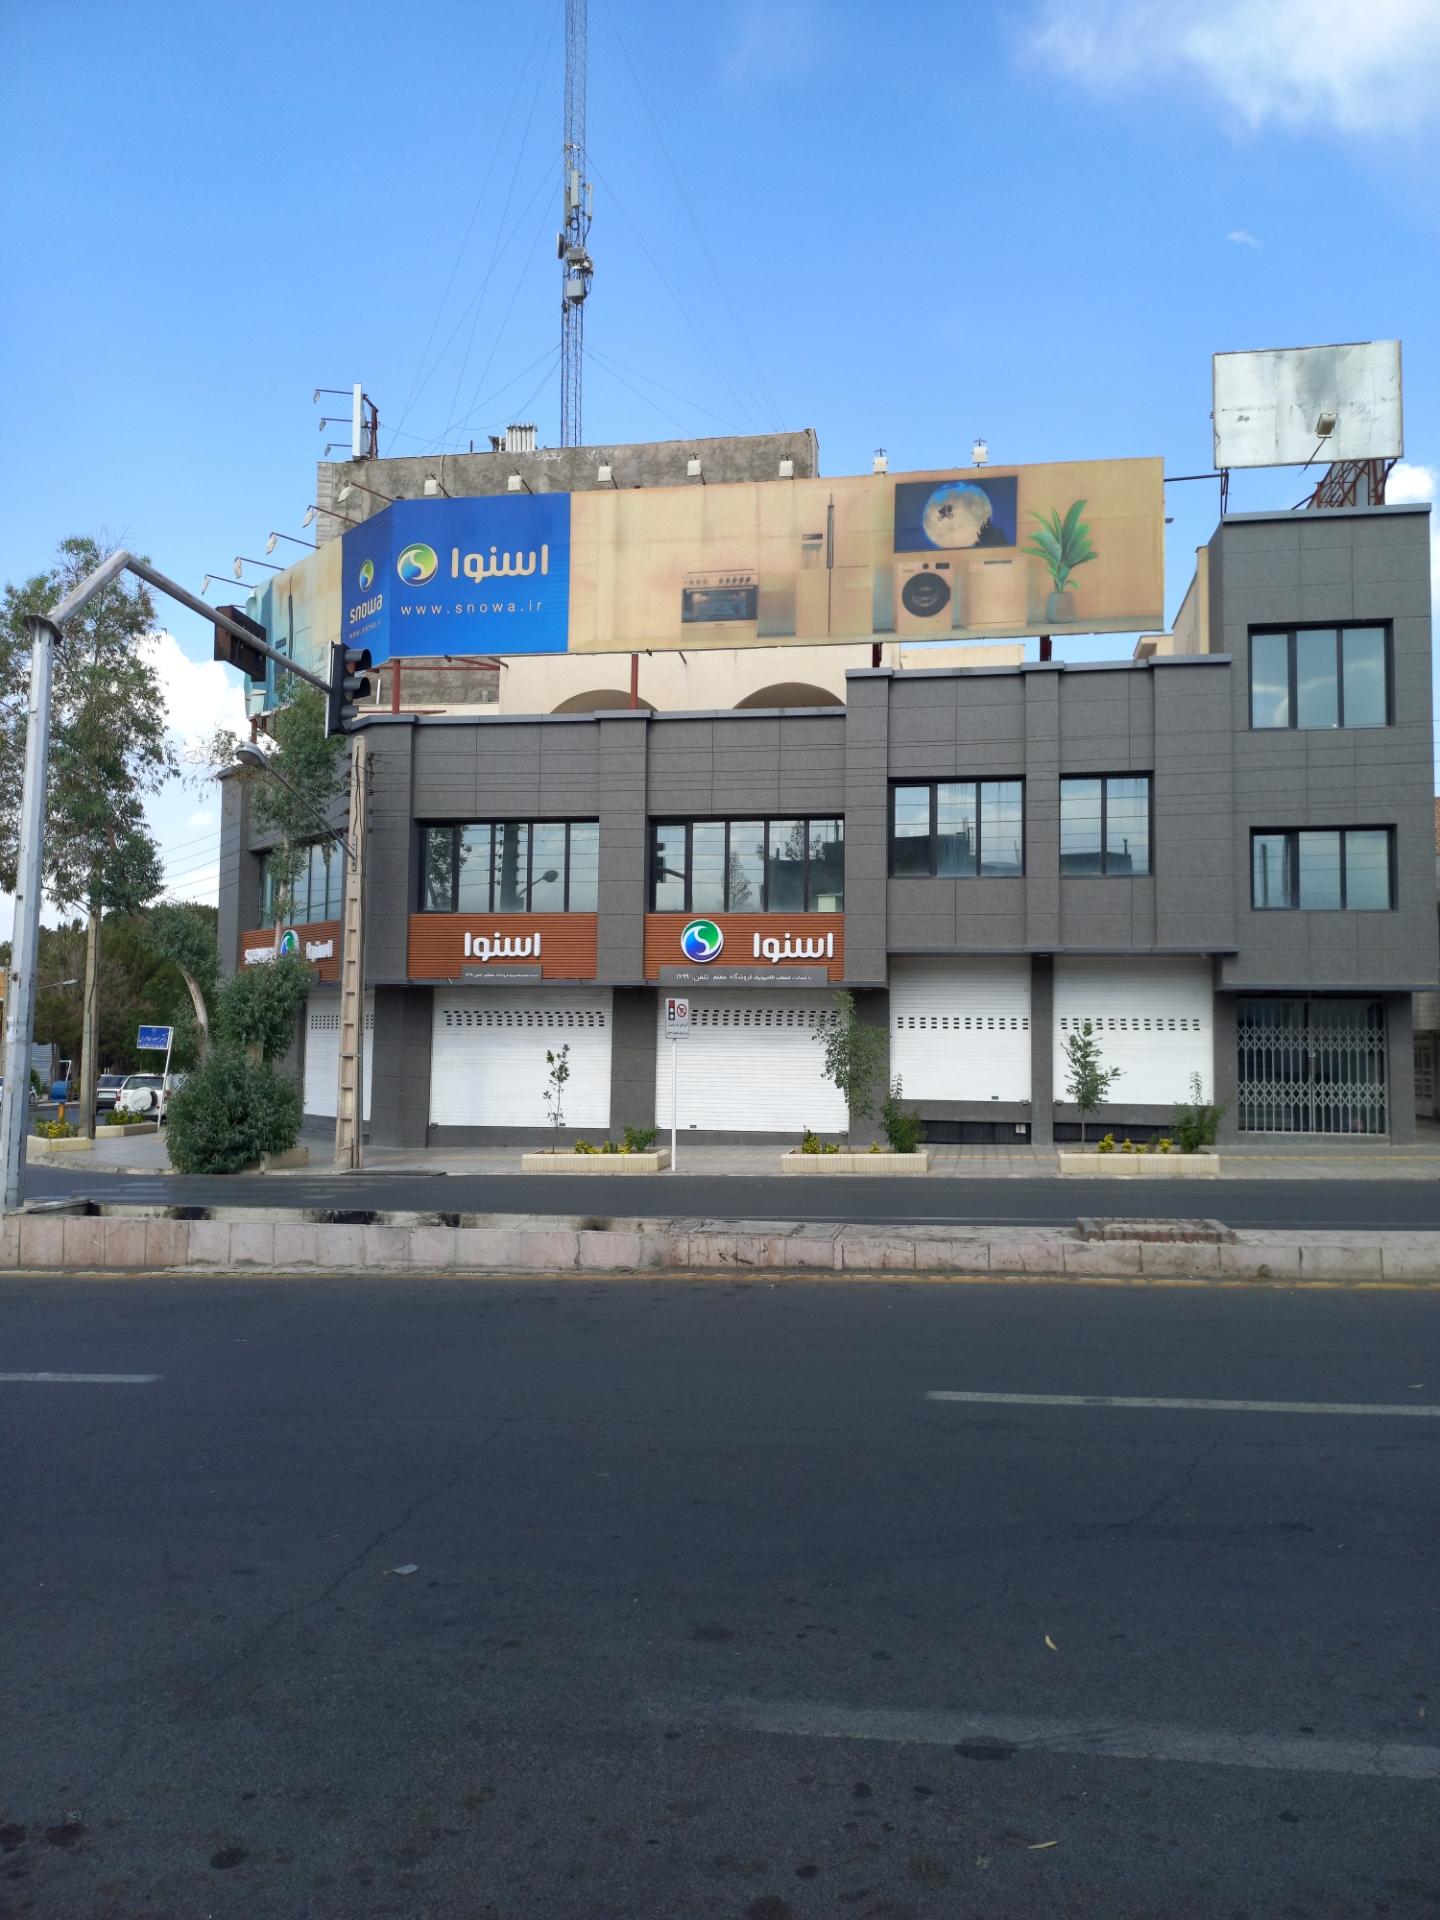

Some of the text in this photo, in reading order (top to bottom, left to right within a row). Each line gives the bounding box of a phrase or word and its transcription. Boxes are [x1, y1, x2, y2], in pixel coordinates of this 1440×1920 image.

[451, 543, 549, 584] اسنوا
[349, 593, 383, 624] snowa
[401, 599, 542, 616] www.snowa.ir
[464, 932, 541, 962] اسنوا
[753, 932, 833, 963] اسنوا
